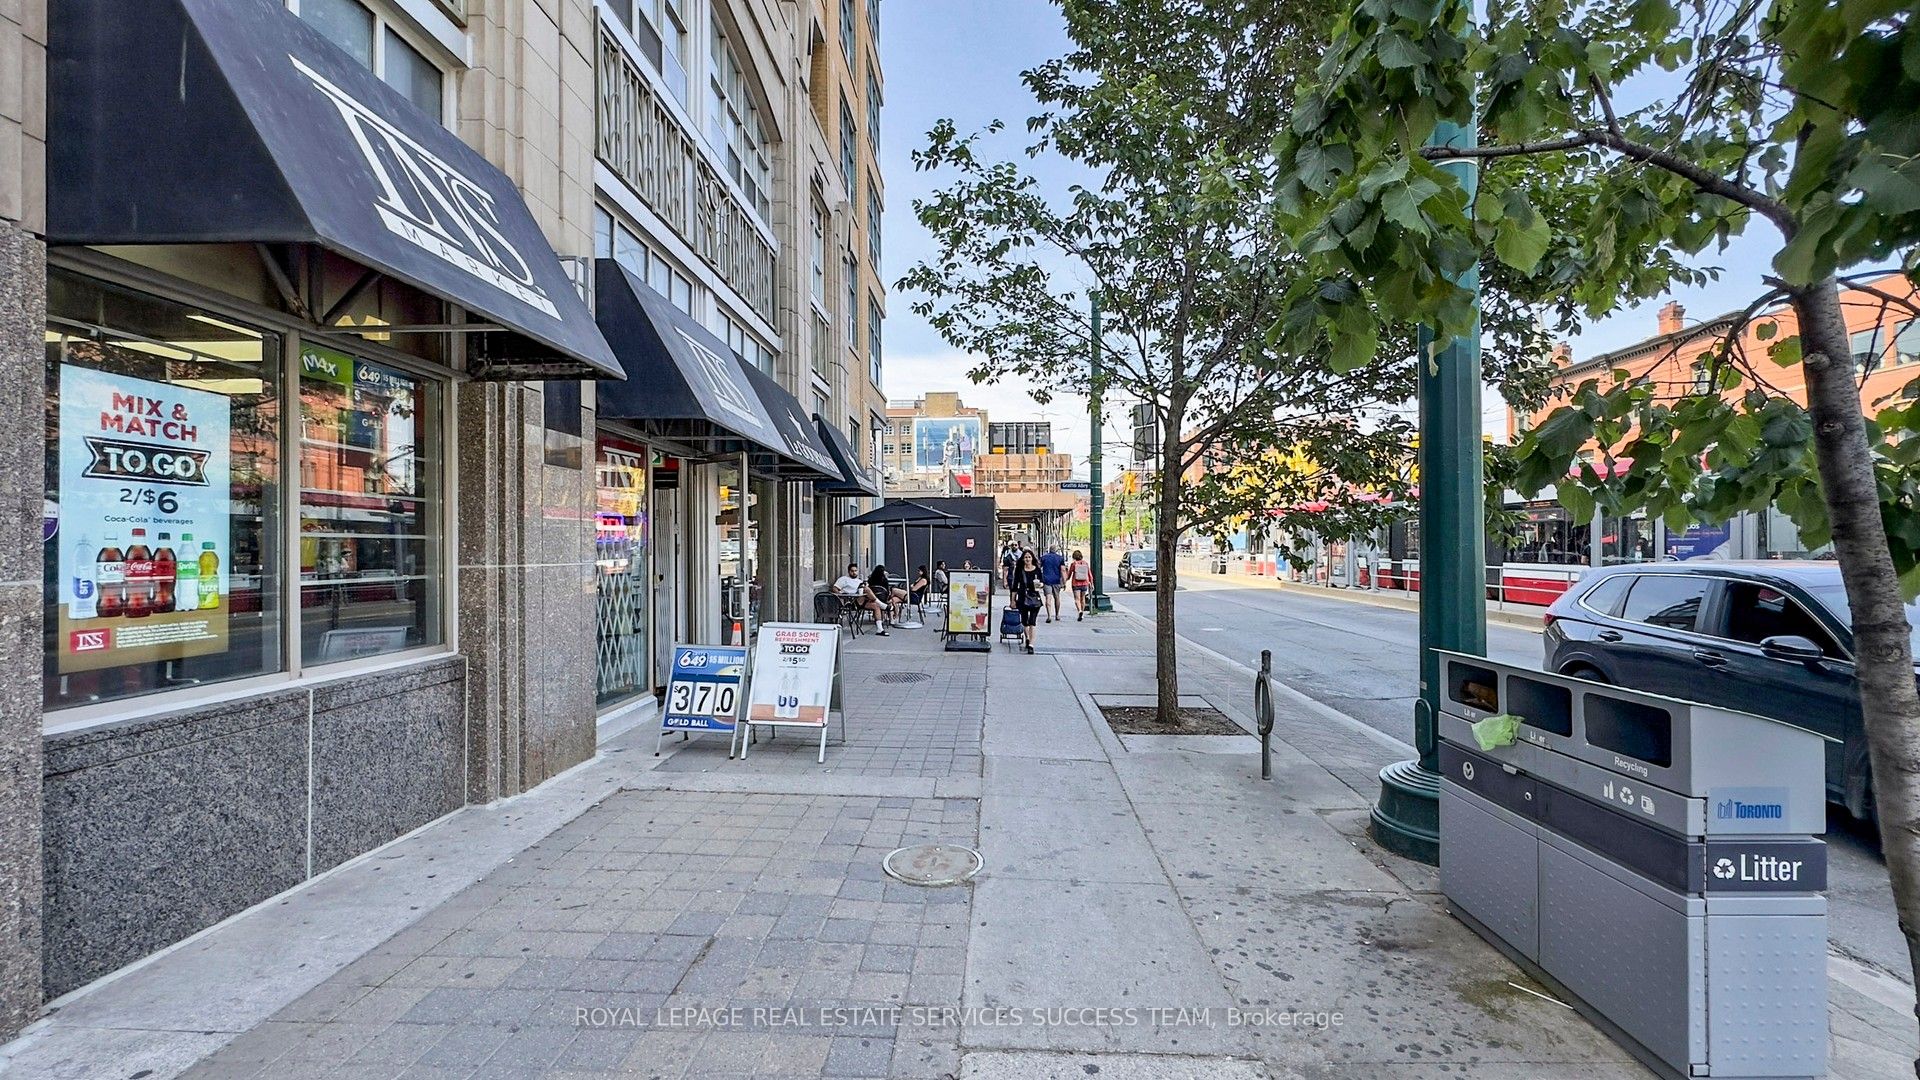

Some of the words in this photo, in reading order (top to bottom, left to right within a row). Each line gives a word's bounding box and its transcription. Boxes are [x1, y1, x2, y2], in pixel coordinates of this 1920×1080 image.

[402, 222, 549, 312] MARKET
[302, 354, 337, 377] MAX
[359, 365, 381, 383] 649
[112, 392, 163, 418] MIX
[171, 403, 188, 421] &
[100, 411, 197, 442] MATCH
[103, 446, 147, 474] TO
[152, 452, 197, 478] GO
[119, 488, 179, 514] 2/$6
[153, 517, 194, 526] beverages
[680, 651, 707, 667] 649
[690, 719, 708, 727] BALL
[1614, 756, 1649, 777] Recycling
[1740, 853, 1803, 881] Litter
